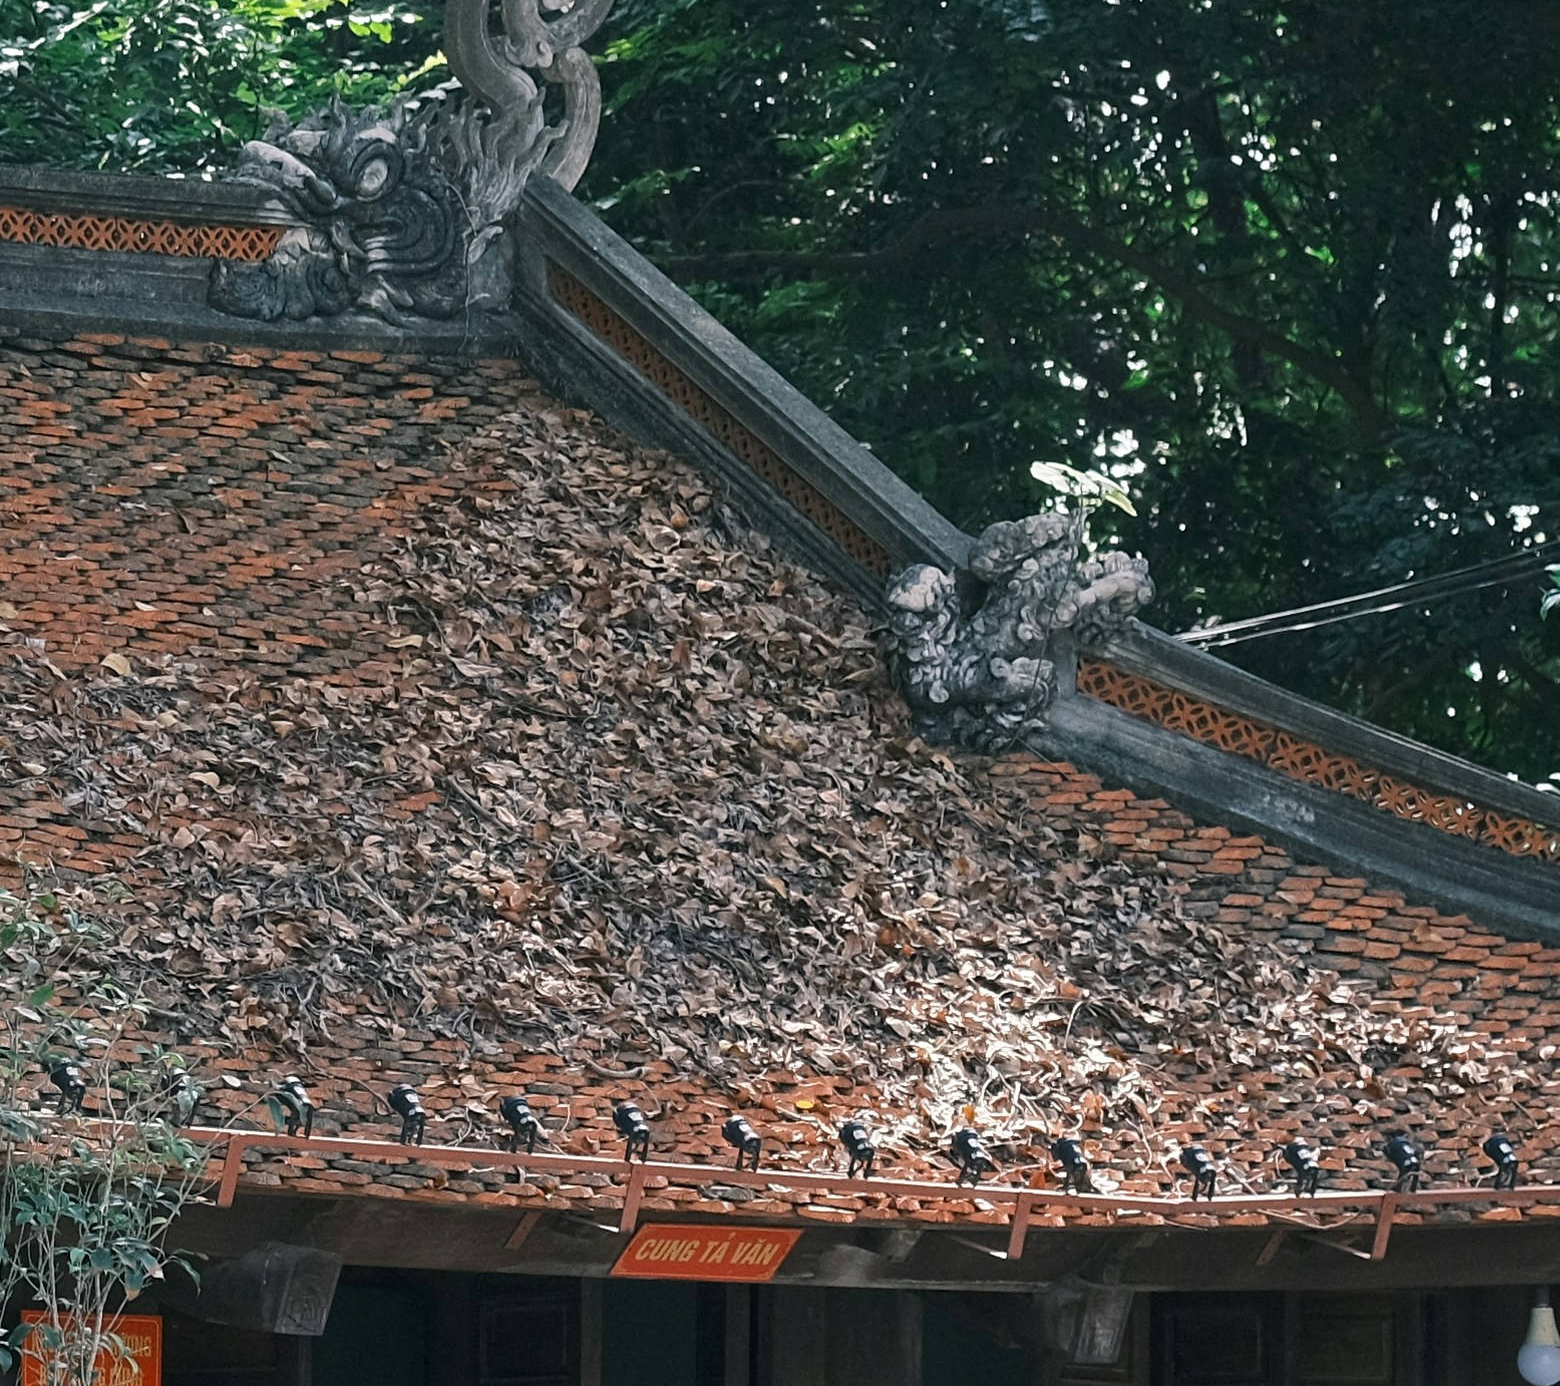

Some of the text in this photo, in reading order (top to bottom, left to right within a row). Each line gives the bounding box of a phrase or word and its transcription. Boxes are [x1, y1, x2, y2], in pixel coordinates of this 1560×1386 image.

[635, 1231, 781, 1266] CUNG TẢ VĂN
